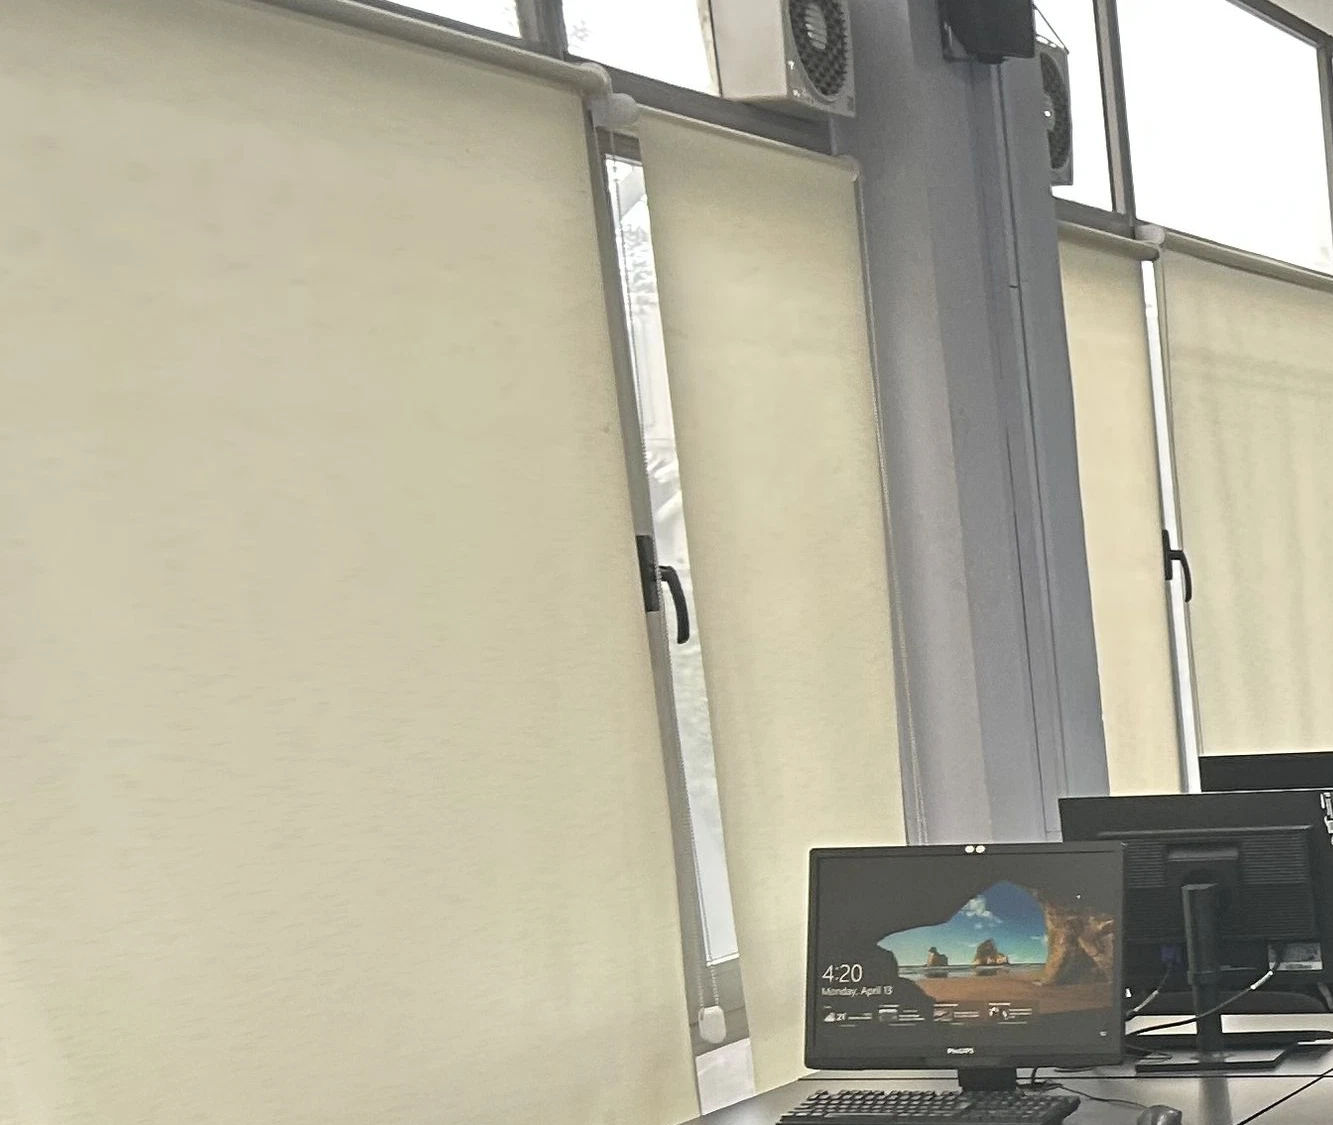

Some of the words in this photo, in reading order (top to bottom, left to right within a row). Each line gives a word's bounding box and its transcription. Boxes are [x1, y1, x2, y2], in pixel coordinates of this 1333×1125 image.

[822, 964, 863, 983] 4:20
[861, 986, 881, 996] April
[883, 986, 893, 995] 13
